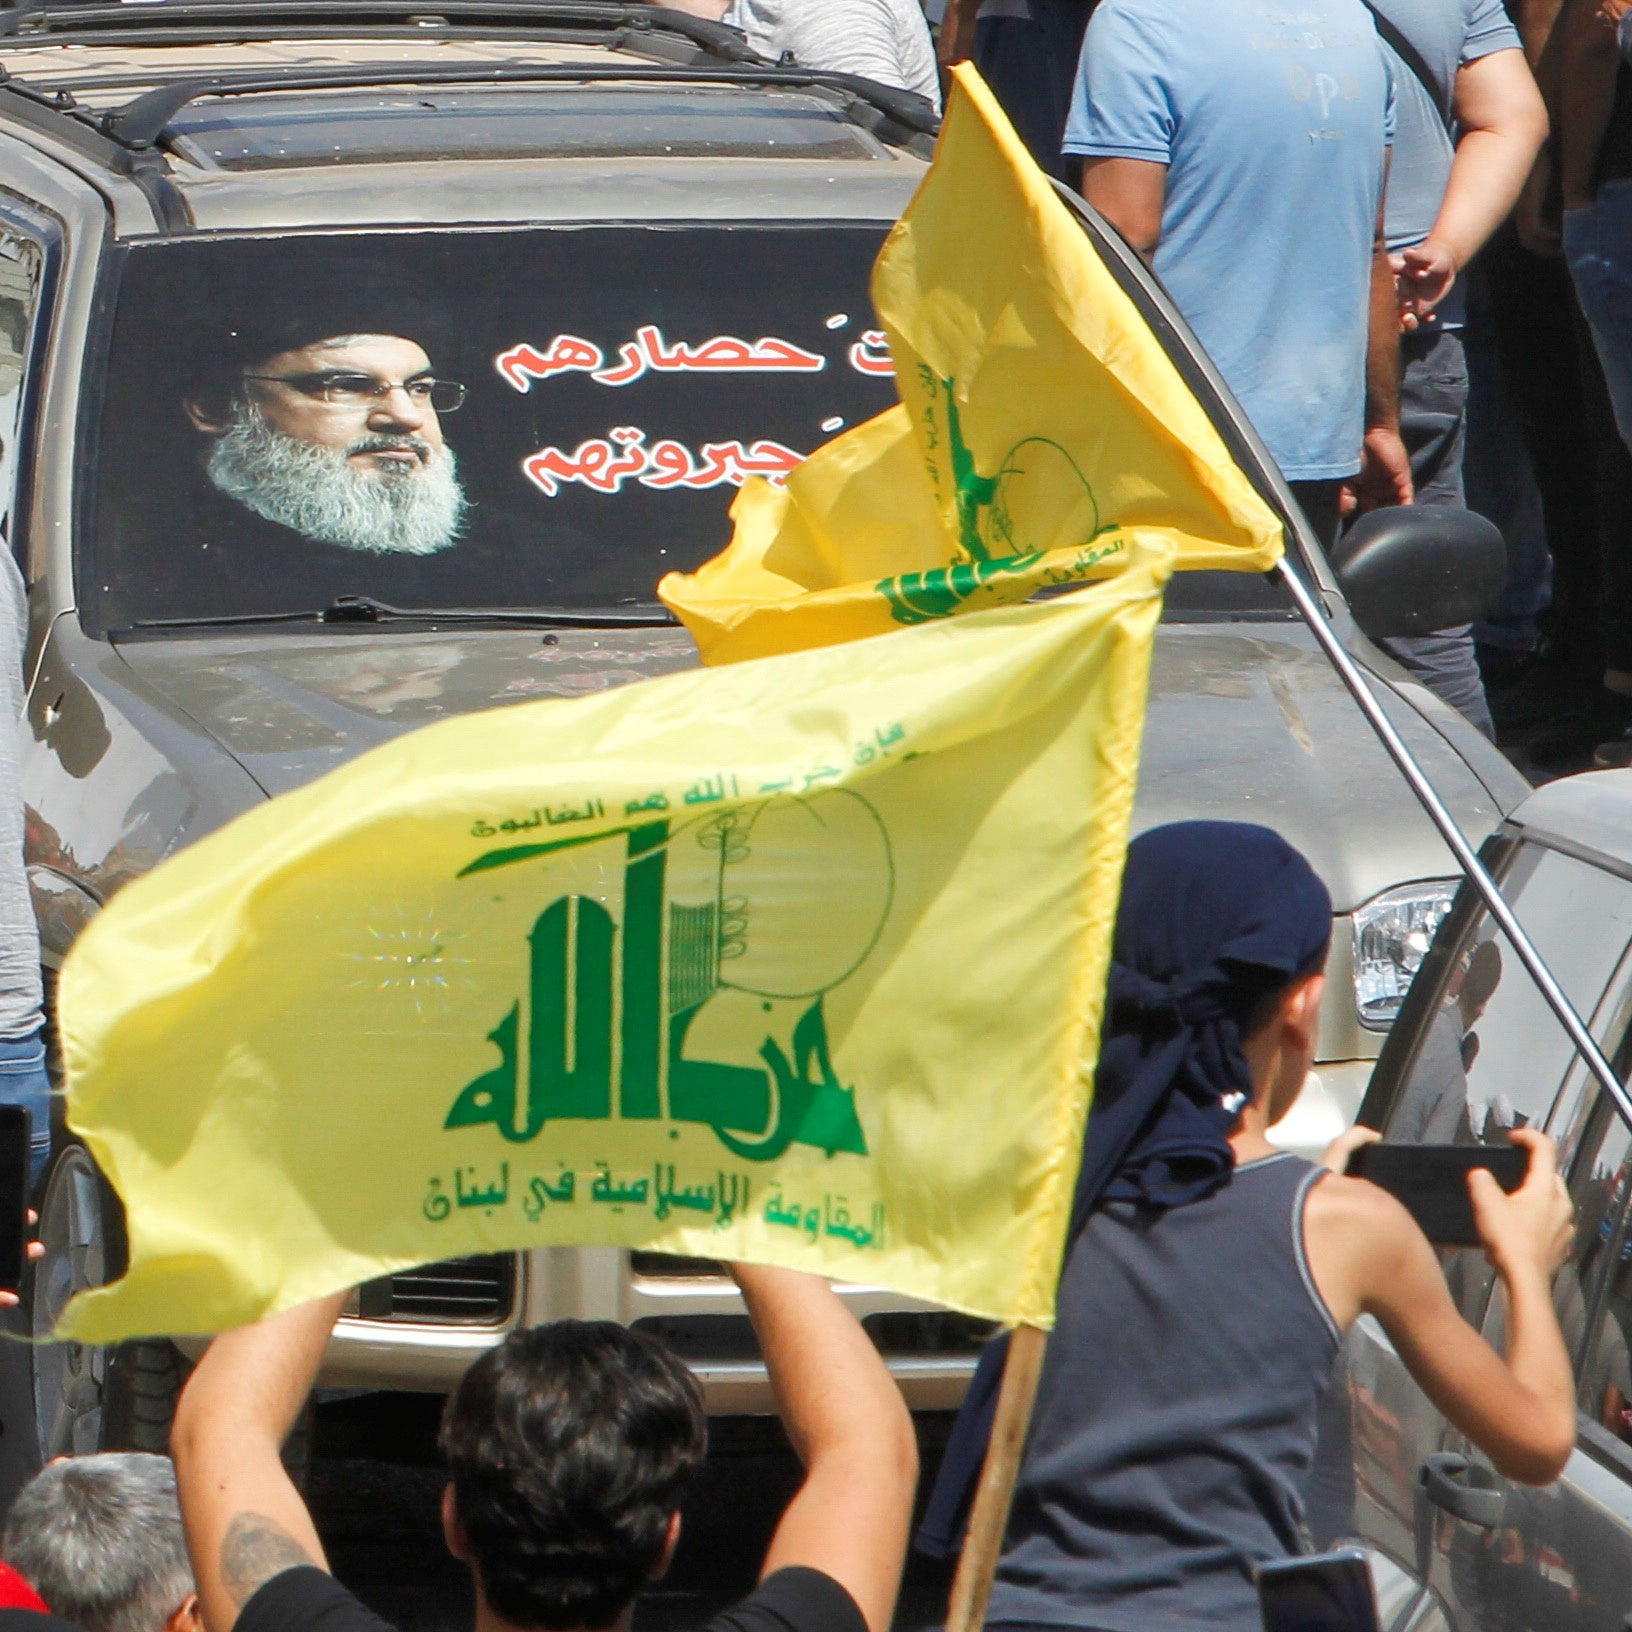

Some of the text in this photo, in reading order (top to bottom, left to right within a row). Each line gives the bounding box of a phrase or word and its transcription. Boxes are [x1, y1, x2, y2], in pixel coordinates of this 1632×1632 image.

[495, 325, 826, 394] حصارهم
[624, 793, 671, 817] هم
[682, 772, 740, 807] الله
[422, 1161, 509, 1223] لبنان
[522, 1161, 576, 1224] في
[763, 1178, 886, 1252] المقاومة
